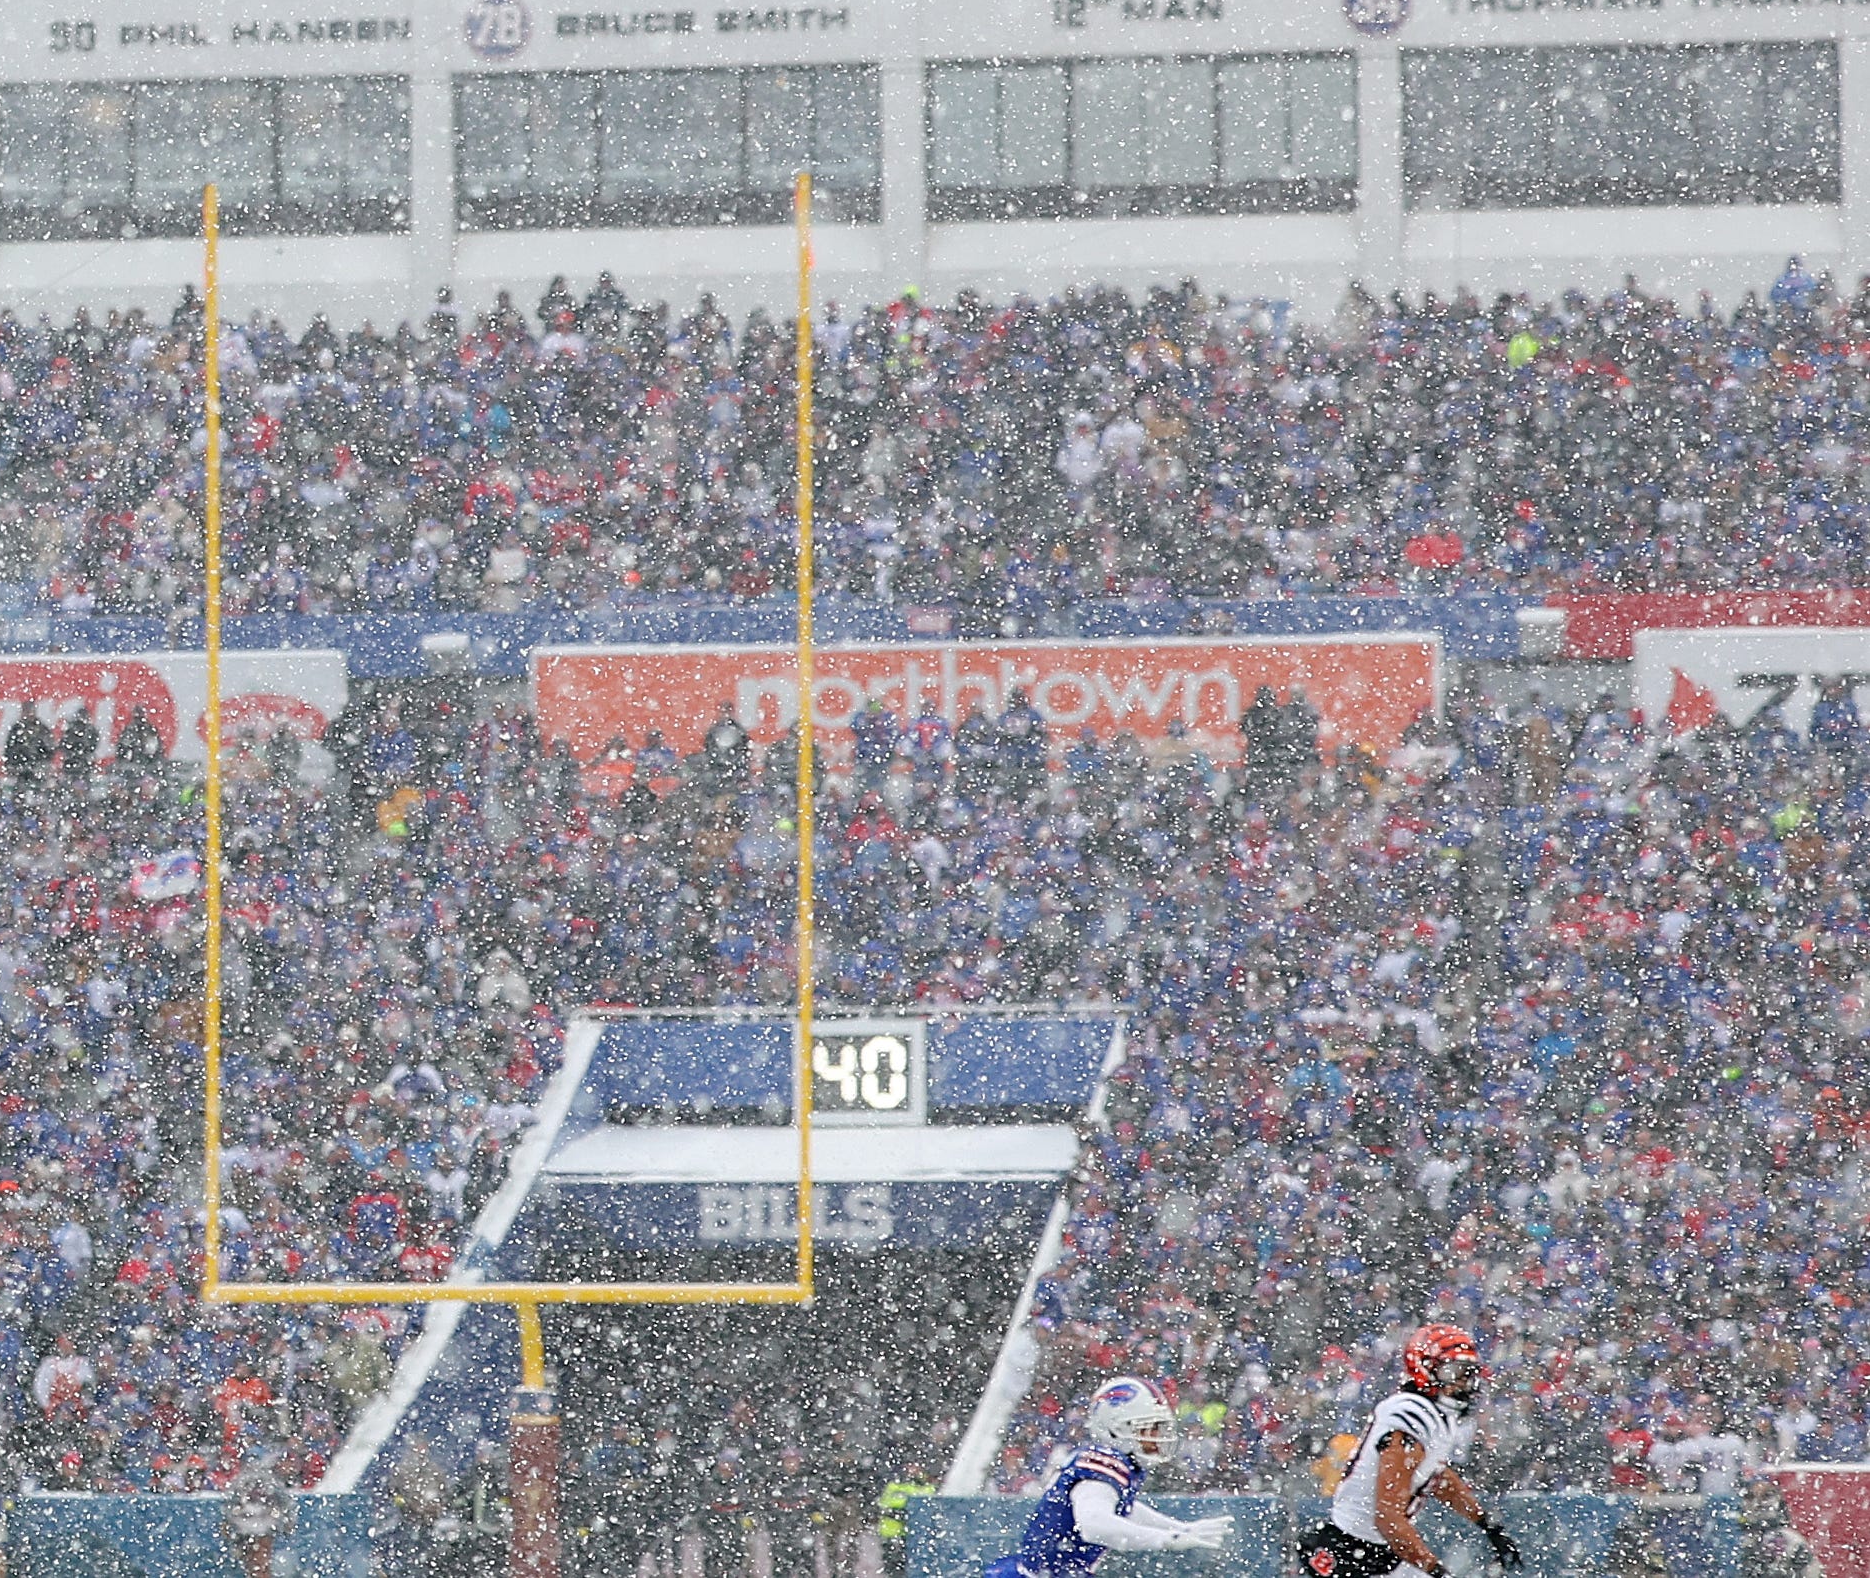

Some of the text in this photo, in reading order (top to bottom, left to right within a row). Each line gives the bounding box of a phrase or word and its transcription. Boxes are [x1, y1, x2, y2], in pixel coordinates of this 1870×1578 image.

[119, 22, 210, 49] PHIL
[812, 1035, 908, 1109] 40
[698, 1185, 893, 1242] BILLS
